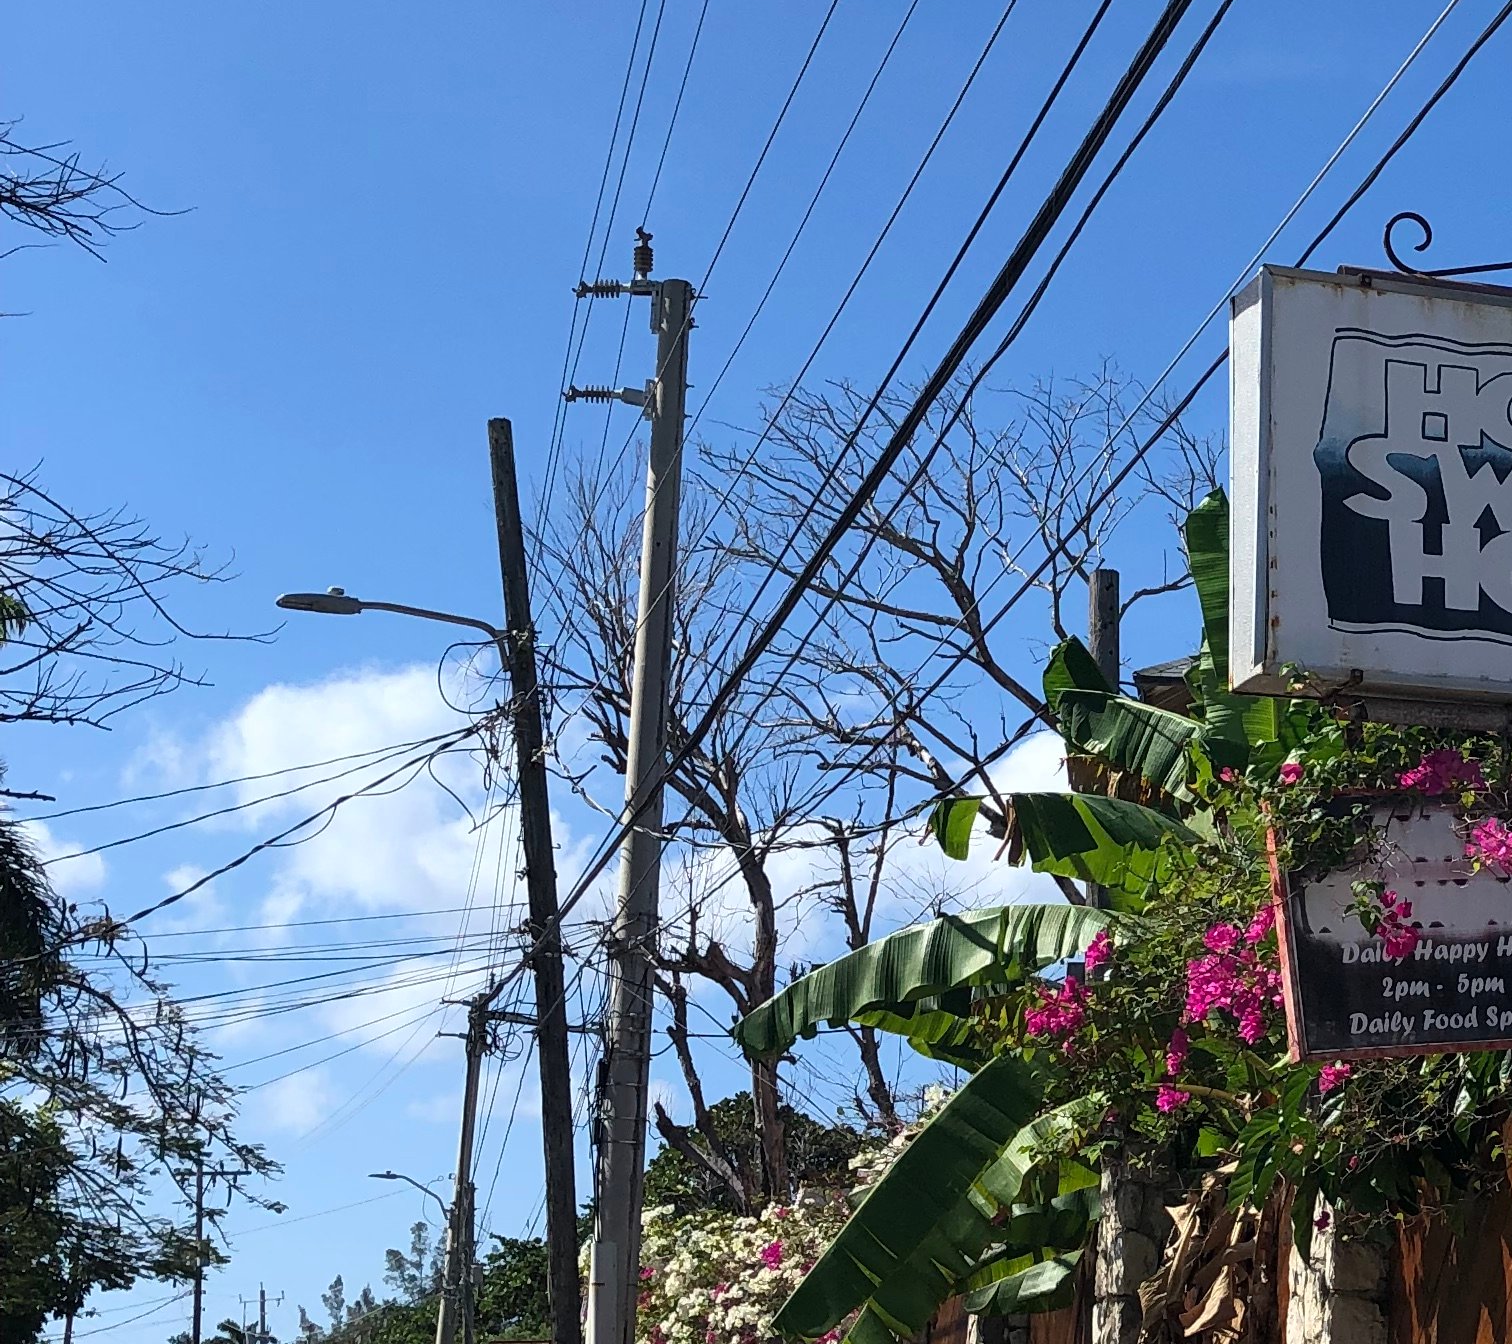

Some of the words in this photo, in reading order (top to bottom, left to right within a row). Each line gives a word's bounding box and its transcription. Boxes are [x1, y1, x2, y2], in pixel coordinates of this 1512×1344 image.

[1414, 939, 1489, 965] Happy
[1382, 977, 1430, 1001] 2pm
[1457, 973, 1505, 998] 5pm
[1350, 1011, 1415, 1036] Daily
[1423, 1006, 1478, 1031] Food
